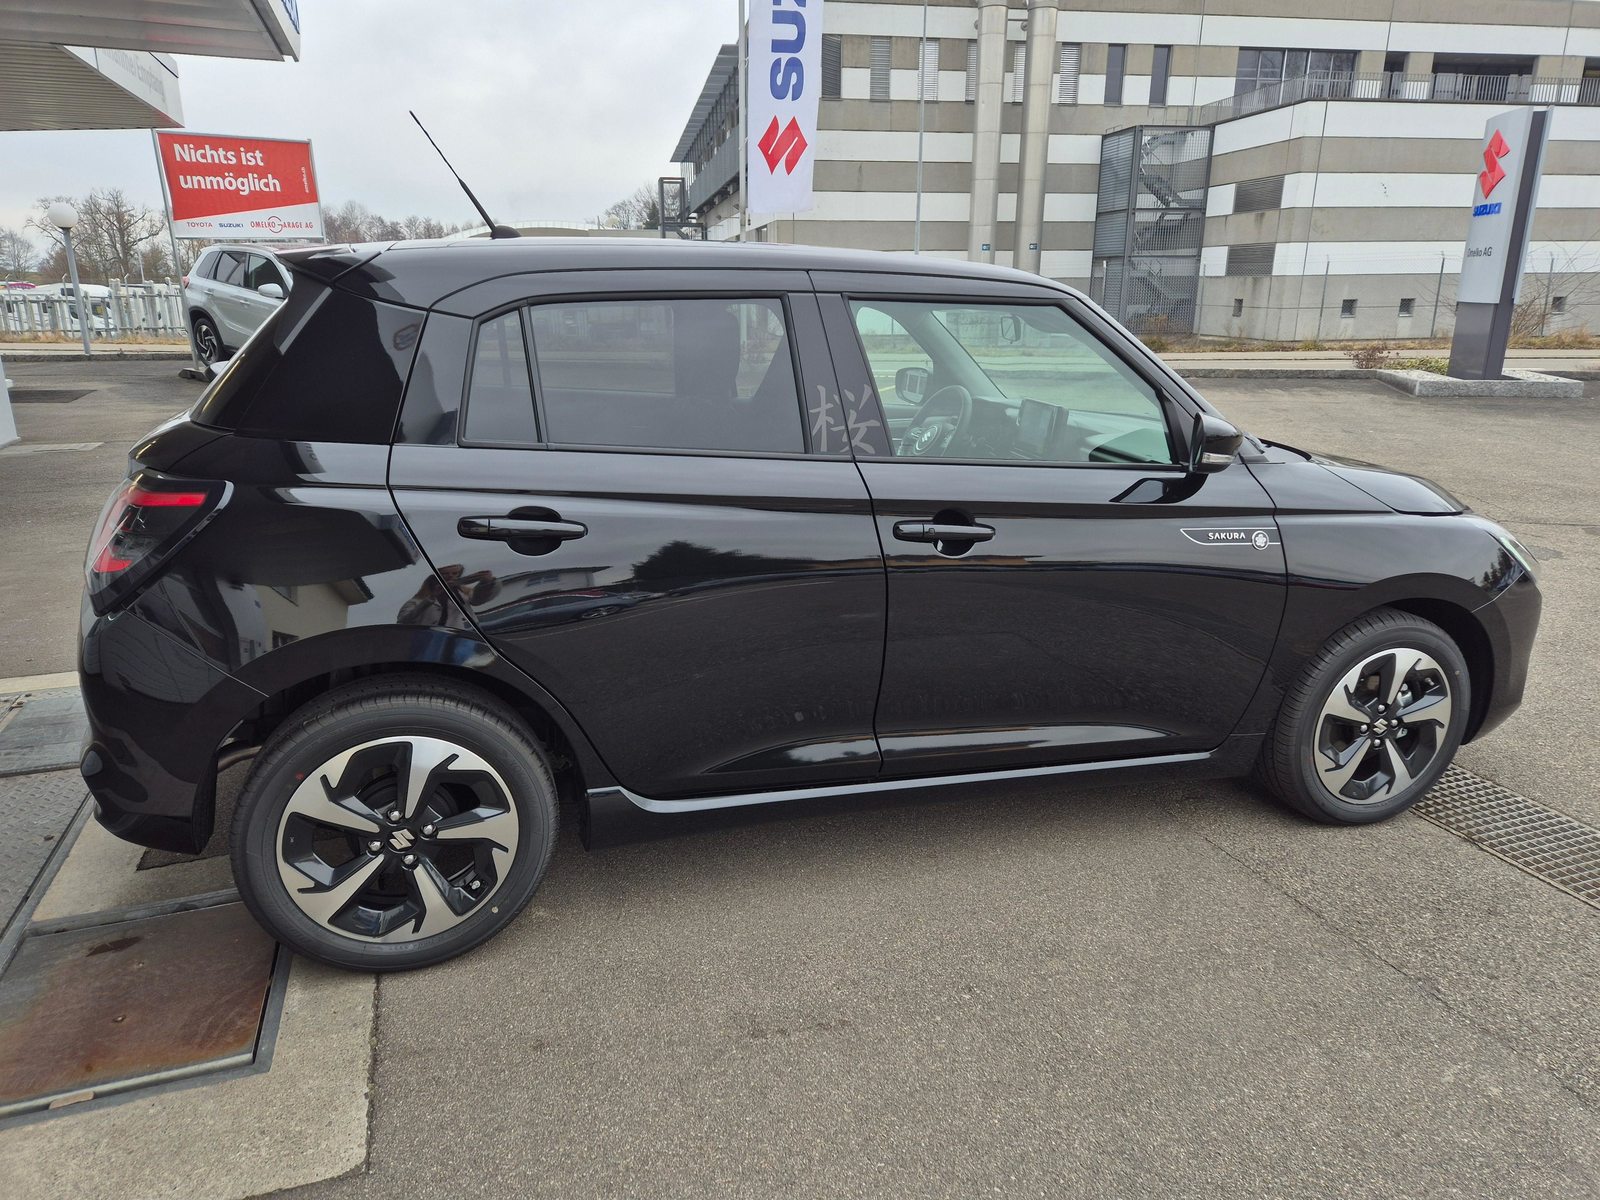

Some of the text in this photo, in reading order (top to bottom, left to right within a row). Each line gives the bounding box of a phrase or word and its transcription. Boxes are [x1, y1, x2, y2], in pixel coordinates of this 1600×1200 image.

[770, 0, 807, 101] SU
[173, 143, 264, 166] Nichts ist
[179, 172, 282, 195] unmöglich
[1473, 202, 1502, 216] SUZUKI
[250, 221, 276, 229] OMELKO
[1483, 247, 1493, 257] AG
[808, 384, 881, 455] 桜
[1208, 532, 1246, 540] SAKURA
